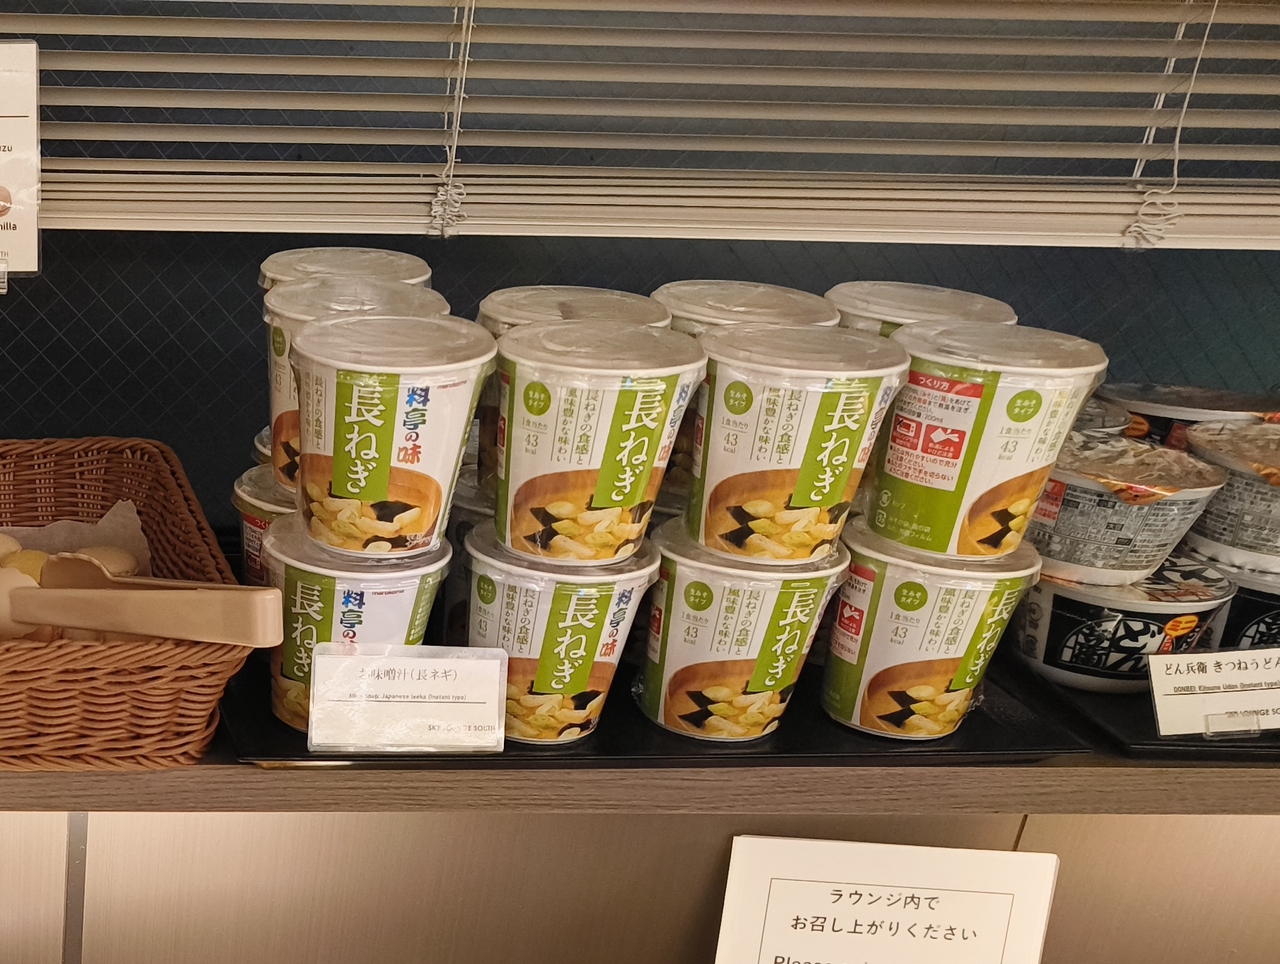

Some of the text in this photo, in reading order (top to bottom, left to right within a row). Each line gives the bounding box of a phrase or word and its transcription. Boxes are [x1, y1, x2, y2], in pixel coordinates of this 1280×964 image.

[919, 376, 950, 390] つくり方
[344, 385, 386, 494] 長ねぎ
[396, 385, 430, 465] 料亭の味
[525, 433, 538, 448] 43
[556, 388, 578, 462] 風味豊かな味わい
[576, 390, 601, 466] 長ねぎの食感と
[611, 390, 664, 501] 長ねぎ
[721, 416, 748, 430] 1食当たり
[723, 446, 736, 454] kcal
[724, 432, 738, 446] 43
[776, 389, 803, 464] 長ねぎの食感と
[810, 391, 865, 502] 長ねぎ
[1000, 441, 1018, 454] 43
[290, 580, 324, 677] 長ねぎ
[501, 584, 518, 648] 風味豊かな味わい
[516, 588, 536, 654] 長ねぎの食感と
[550, 590, 600, 689] 長ねぎ
[600, 588, 634, 658] 料亭の味
[682, 612, 708, 624] 1食当たり
[684, 626, 698, 638] 43
[684, 638, 696, 646] kcal
[716, 588, 740, 653] 風味豊かな味わい
[734, 590, 761, 656] 長ねぎの食感と
[764, 588, 818, 686] 長ねぎ
[890, 612, 920, 624] 1食当たり
[890, 638, 904, 646] kcal
[891, 626, 908, 639] 43
[924, 588, 956, 652] 風味豊かな味わい
[944, 589, 976, 654] 長ねぎの食感と
[966, 590, 1018, 684] 長ねぎ
[1164, 662, 1208, 675] どん兵衛
[790, 914, 978, 941] お召し上がりください
[830, 888, 940, 911] ラウンジ内で
